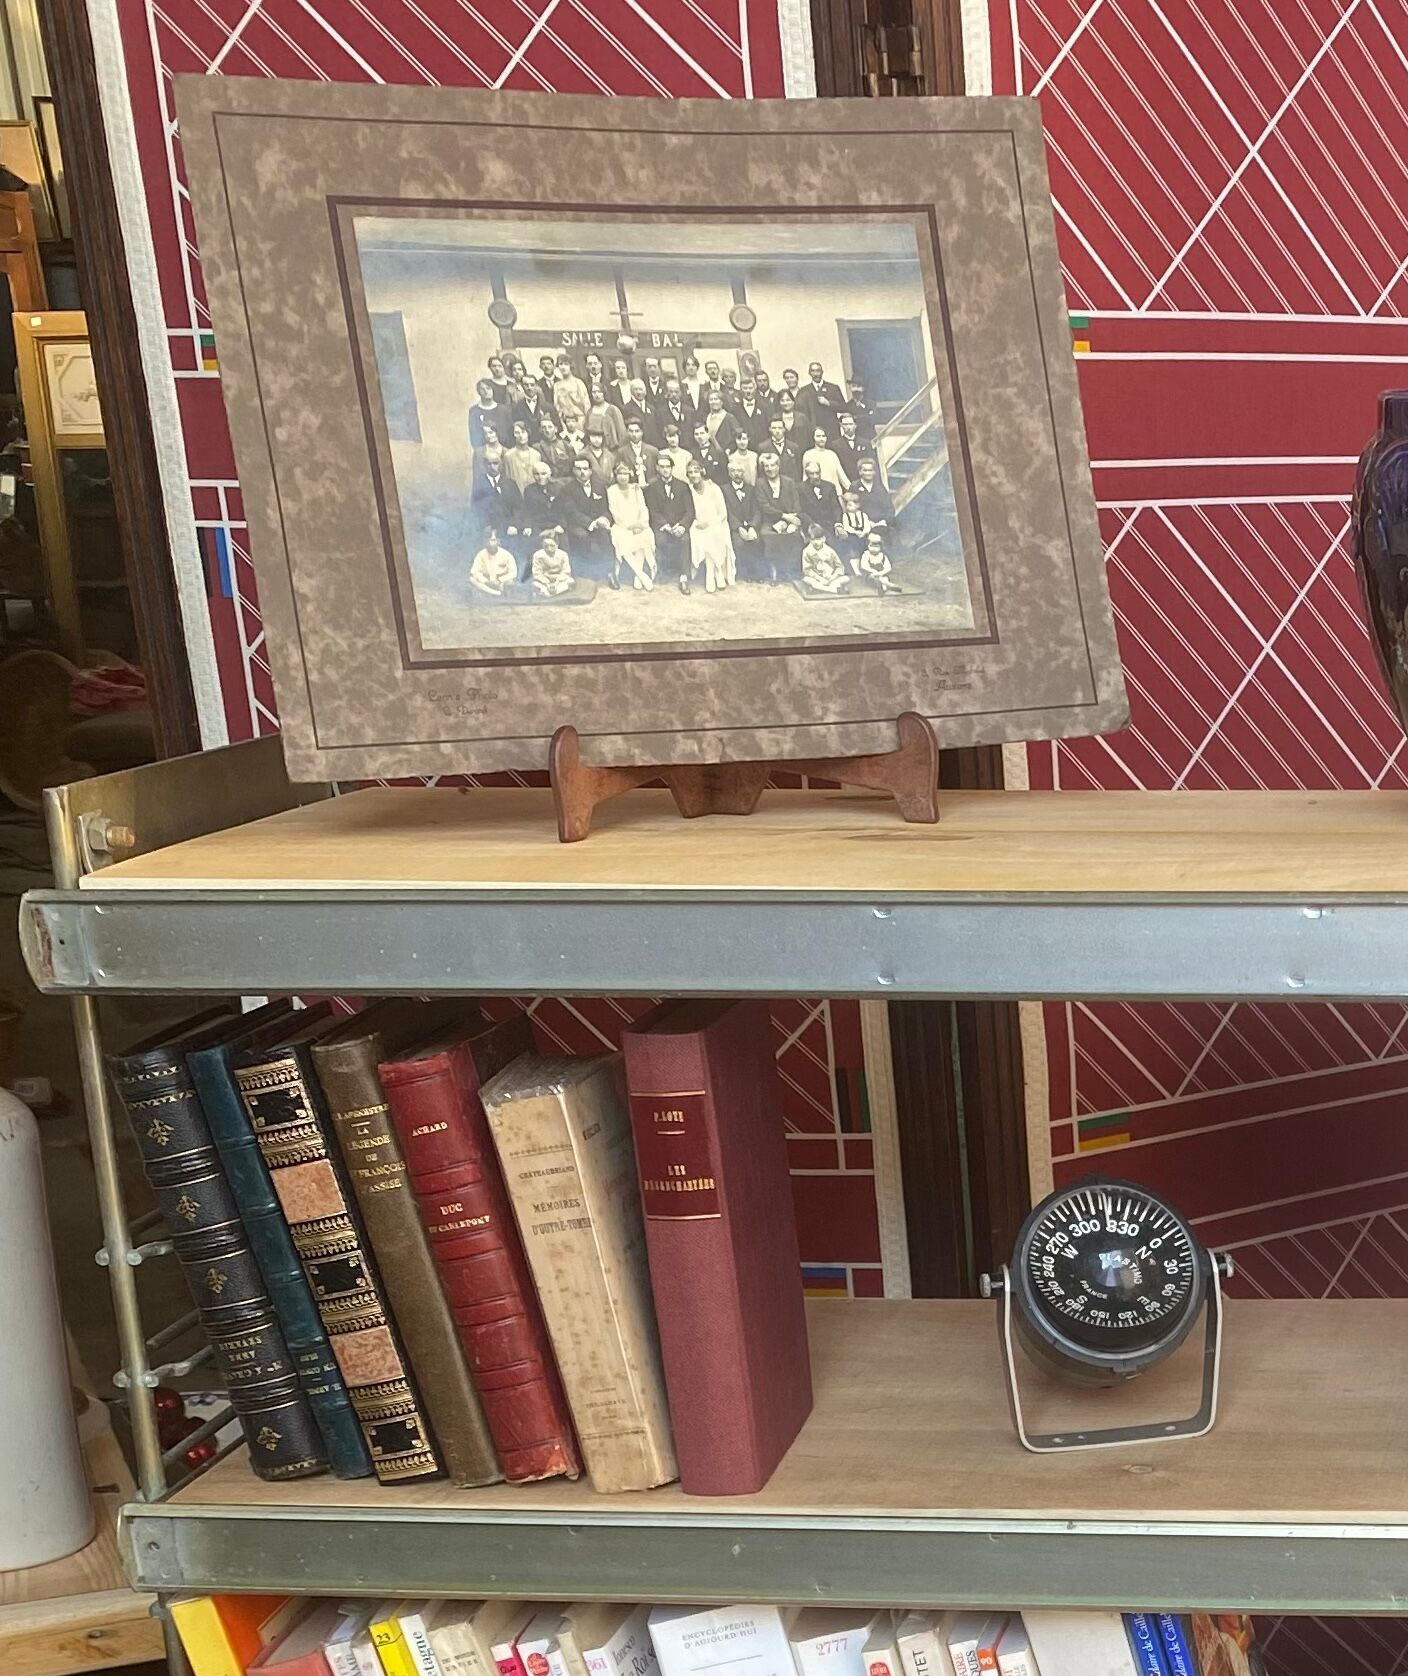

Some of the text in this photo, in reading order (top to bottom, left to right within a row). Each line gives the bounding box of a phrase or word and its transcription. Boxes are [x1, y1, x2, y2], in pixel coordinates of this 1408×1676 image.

[652, 334, 682, 348] BAL
[412, 1122, 448, 1137] ACHARD
[440, 1202, 463, 1214] DUC
[532, 1199, 580, 1213] MÉMOIRES
[1069, 1219, 1100, 1237] 300
[1046, 1231, 1069, 1255] 270
[1150, 1238, 1162, 1249] 0
[1060, 1244, 1079, 1259] W
[1135, 1246, 1152, 1260] N
[1042, 1256, 1054, 1278] 240
[1164, 1259, 1179, 1275] 30
[1048, 1281, 1065, 1295] 210
[1080, 1280, 1108, 1300] FRANCE
[1161, 1283, 1175, 1296] 60
[1066, 1299, 1084, 1311] 180
[1076, 1295, 1088, 1304] S
[1137, 1295, 1150, 1305] E
[1090, 1309, 1109, 1319] 150
[1118, 1310, 1137, 1320] 120
[376, 1632, 392, 1645] 23
[816, 1638, 848, 1656] 2777
